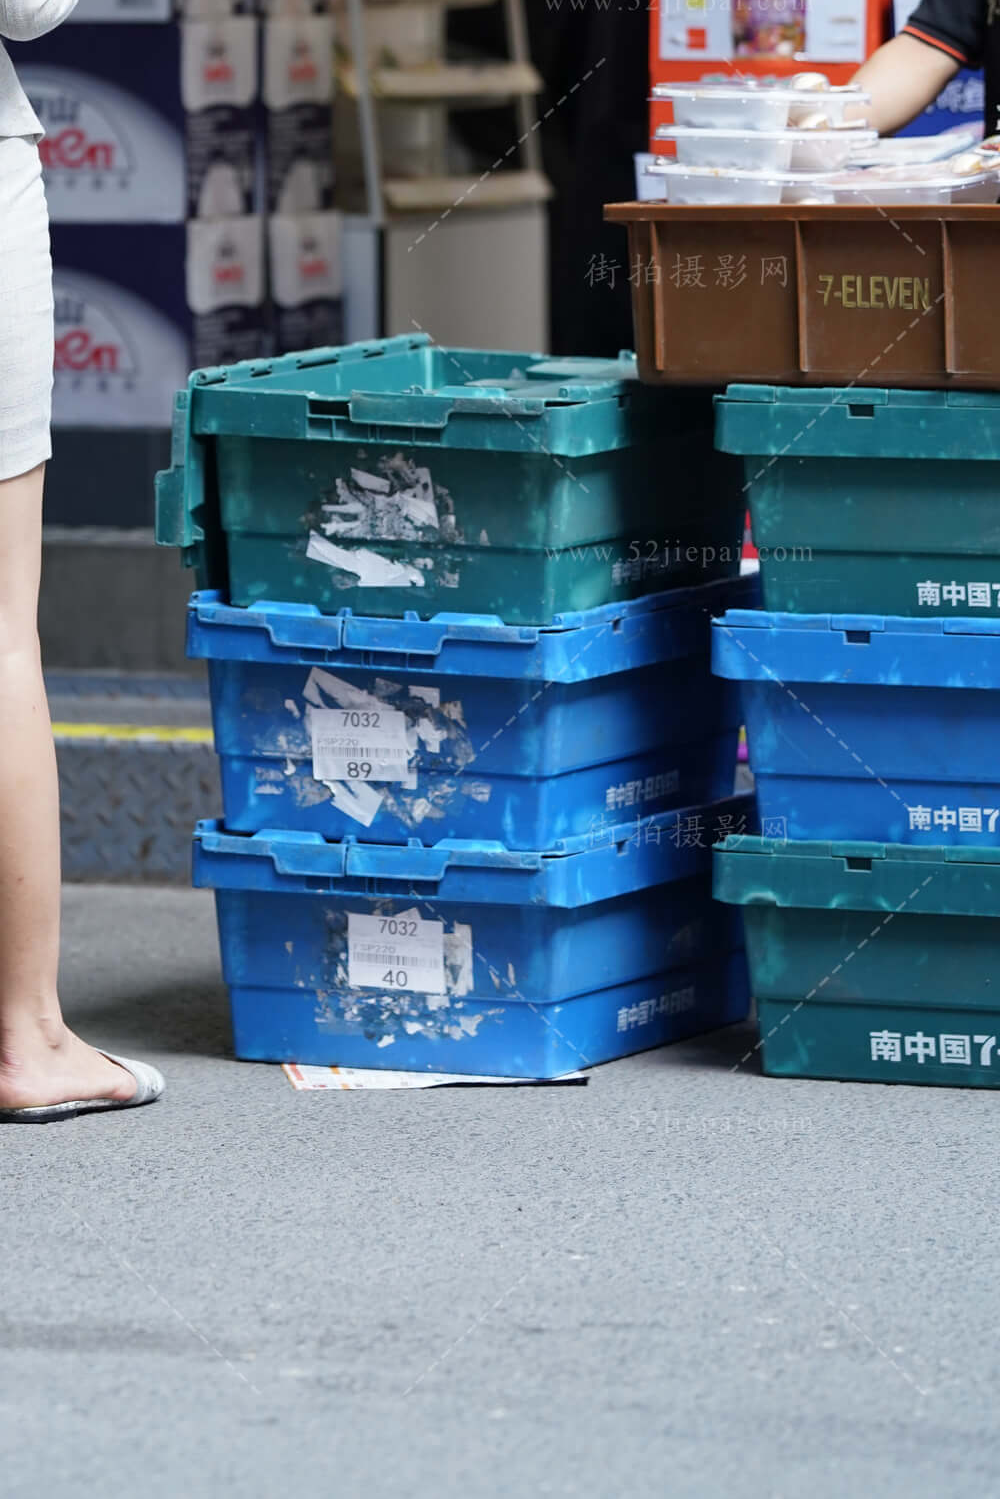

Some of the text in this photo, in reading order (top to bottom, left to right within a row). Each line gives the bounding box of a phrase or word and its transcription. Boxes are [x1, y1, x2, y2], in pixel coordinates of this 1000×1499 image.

[818, 275, 929, 310] 7-ELEVEN
[341, 711, 381, 728] 7032
[346, 761, 372, 779] 89
[378, 918, 418, 937] 7032
[381, 969, 408, 987] 40
[868, 1029, 1000, 1066] 南中国7
